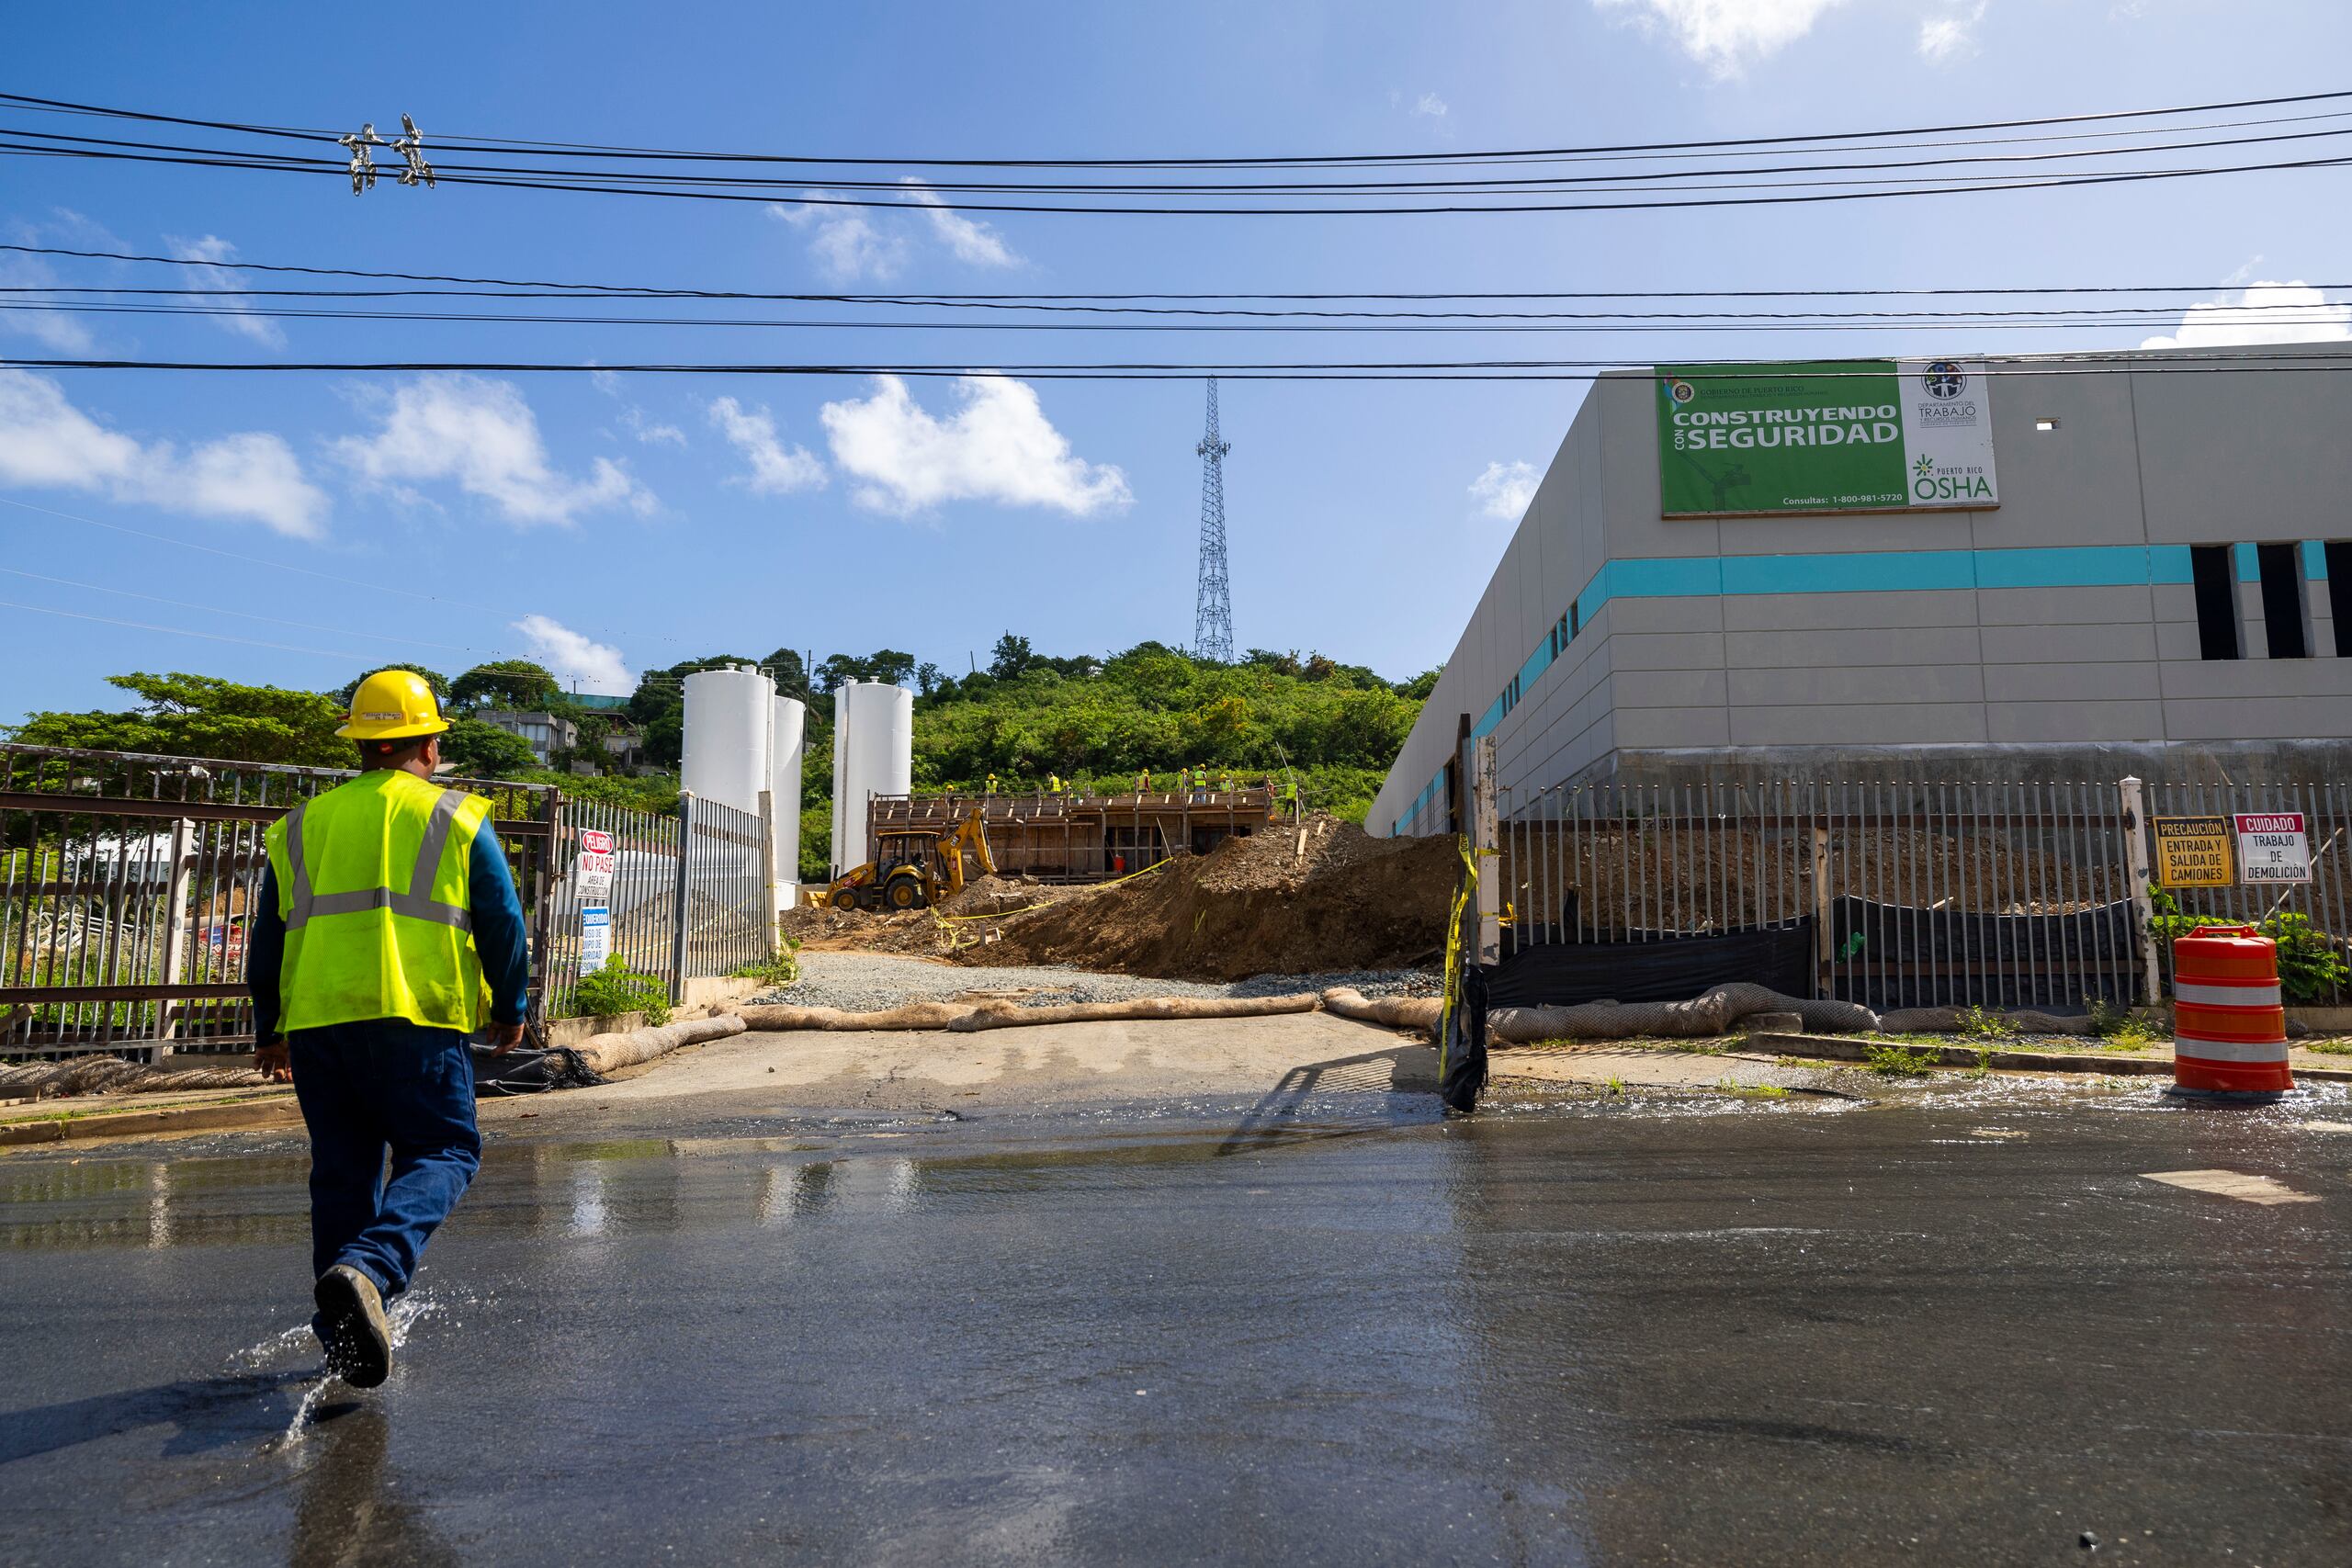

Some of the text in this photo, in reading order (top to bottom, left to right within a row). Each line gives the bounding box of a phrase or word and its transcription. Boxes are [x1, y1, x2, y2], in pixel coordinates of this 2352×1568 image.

[1673, 404, 1897, 426] CONSTRUYENDO
[1918, 405, 1976, 418] TRABAJO
[1674, 429, 1685, 450] CON
[1688, 422, 1899, 450] SEGURIDAD
[1914, 476, 1993, 500] OSHA
[1782, 493, 1903, 505] Consultas: 1-800-981-5720
[2161, 820, 2222, 836] PRECAUCIÓN
[2245, 818, 2296, 832] CUIDADO
[586, 834, 611, 852] PELIGRO
[2166, 840, 2222, 852] ENTRADA Y
[2253, 835, 2295, 847] TRABAJO
[582, 854, 613, 874] NO PASE
[2169, 853, 2222, 867] SALIDA DE
[2270, 851, 2283, 863] DE
[2171, 868, 2222, 881] CAMIONES
[2248, 863, 2306, 879] DEMOLICIÓN
[583, 913, 608, 925] EQUERIDO
[584, 928, 602, 939] USO DE
[582, 939, 602, 950] UIPO DE
